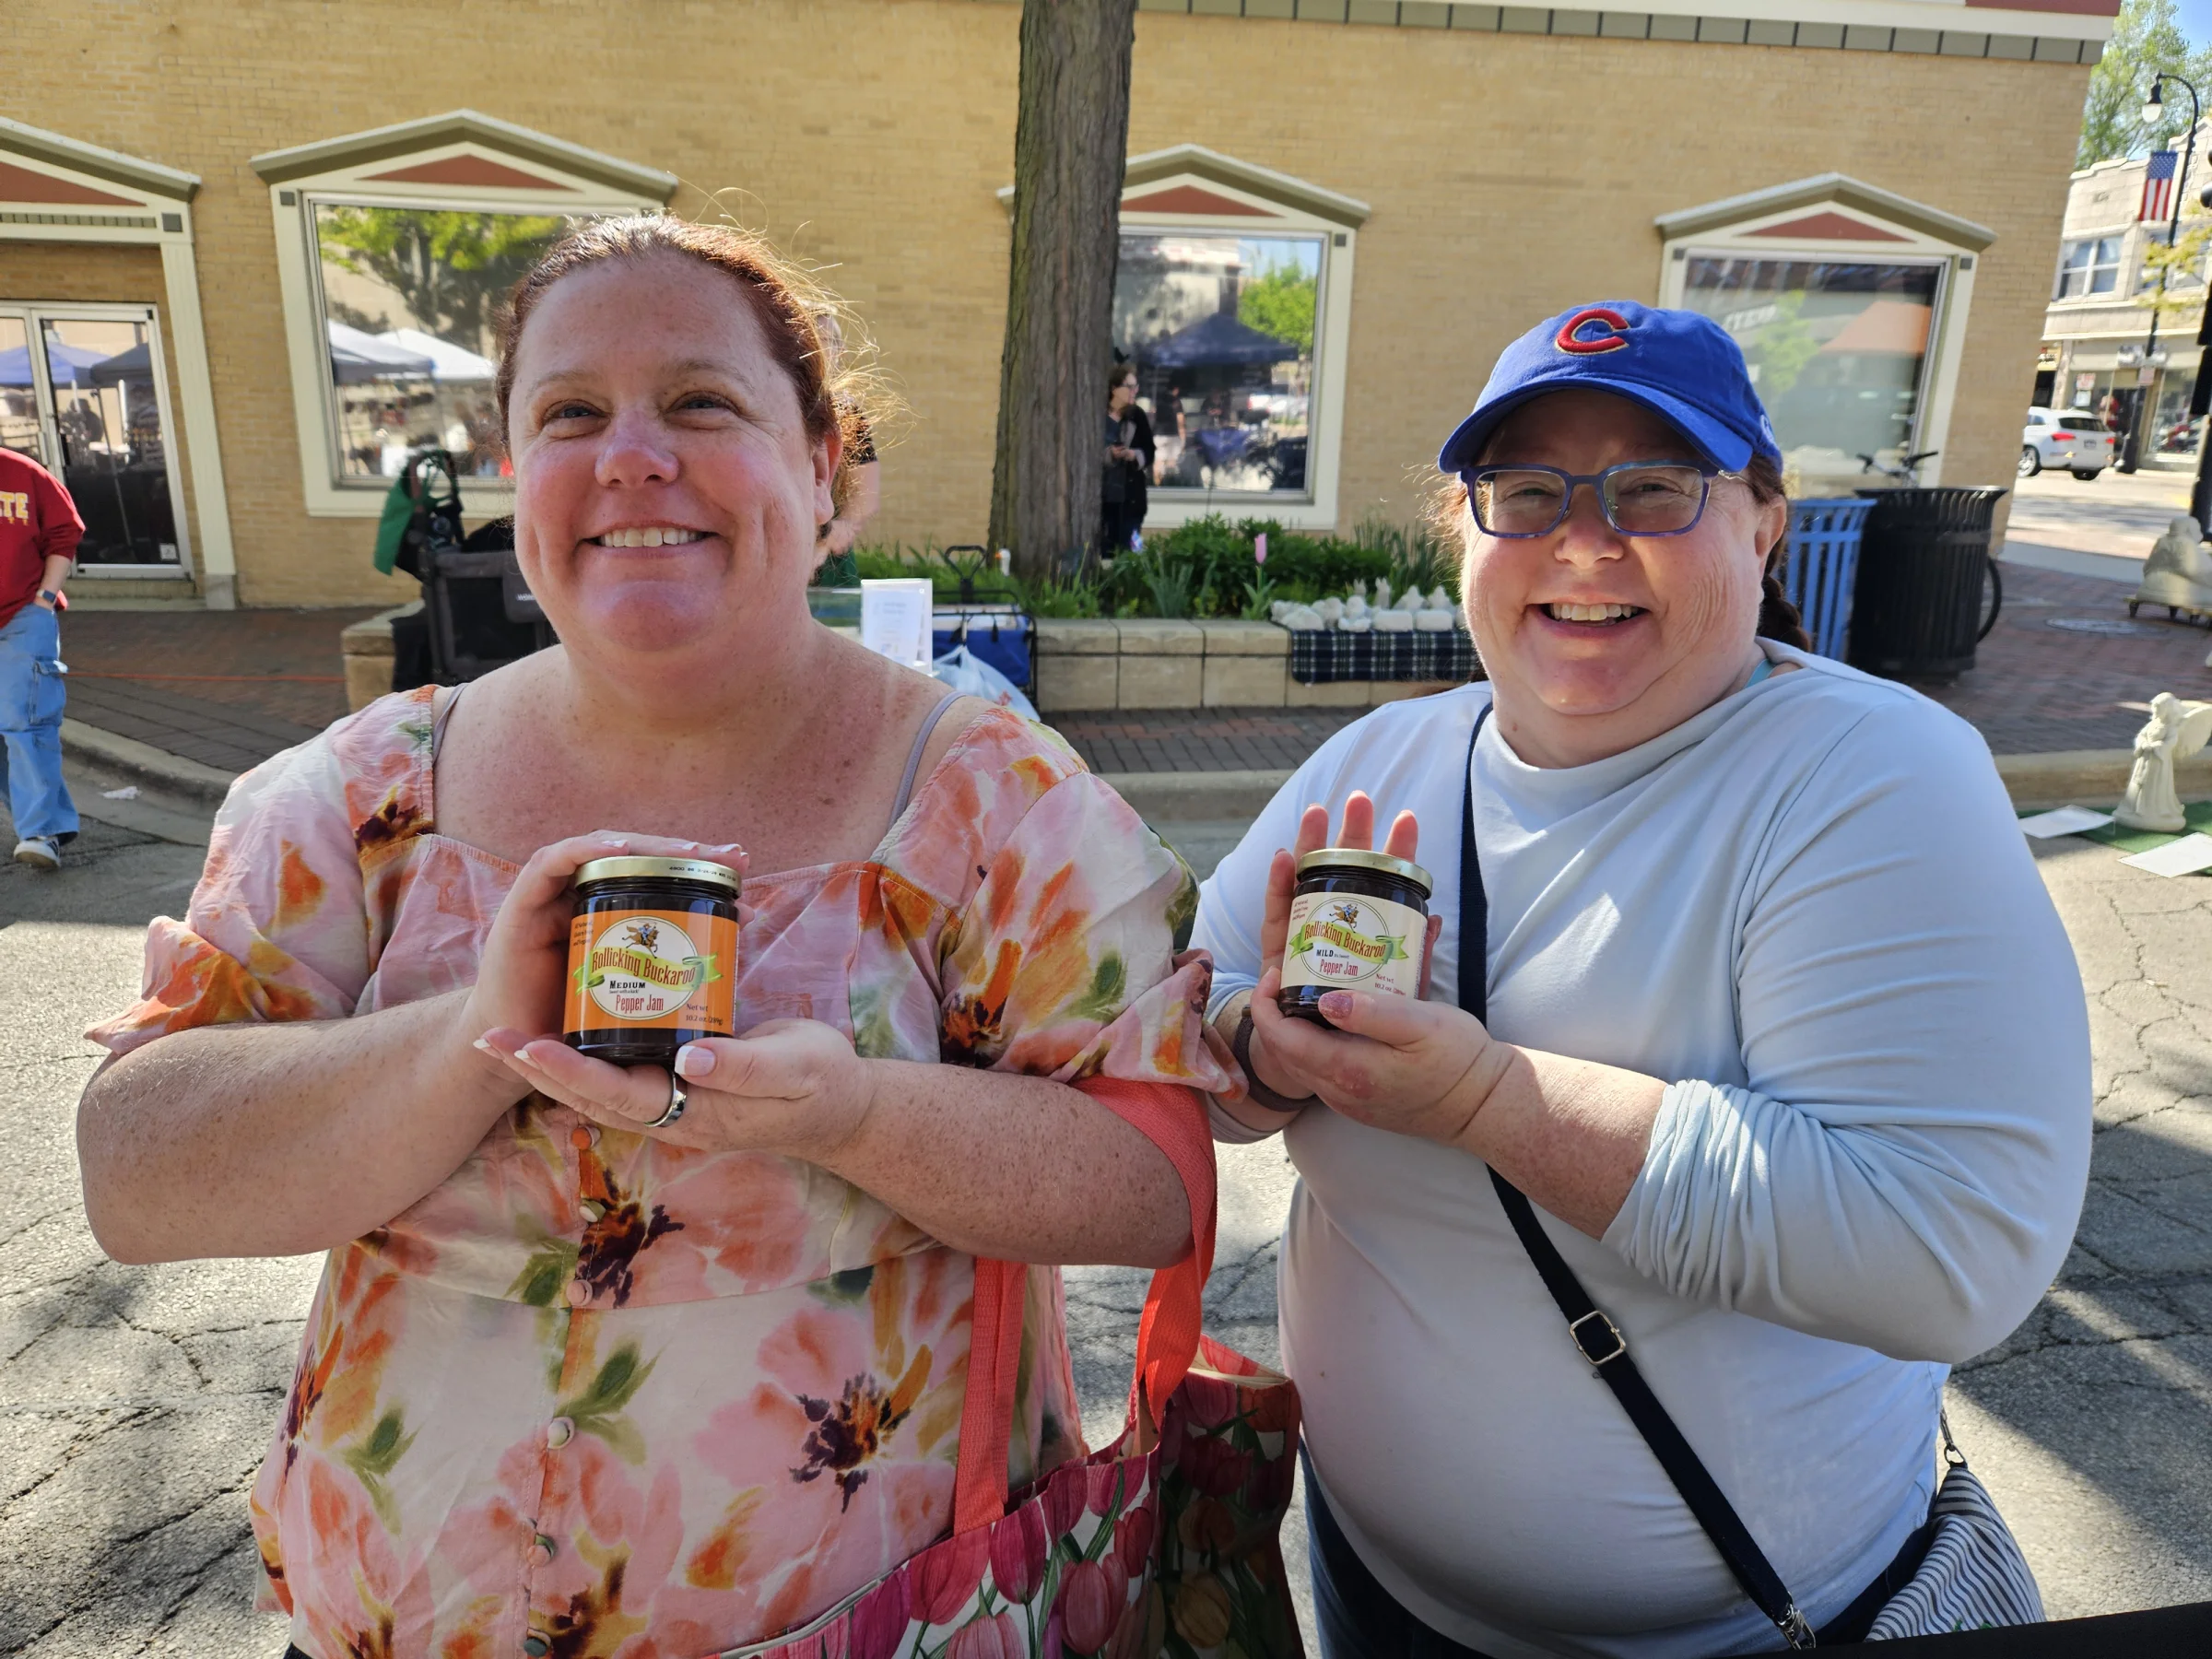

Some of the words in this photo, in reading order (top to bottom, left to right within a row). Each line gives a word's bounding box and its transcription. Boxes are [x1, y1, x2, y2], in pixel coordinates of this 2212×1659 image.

[1555, 308, 1630, 356] C
[0, 490, 29, 520] TE
[1303, 921, 1343, 947] Rollicking
[1344, 932, 1386, 958] Buckaroo
[592, 947, 641, 977] Rollicking
[643, 959, 695, 986] Buckaroo
[1320, 959, 1343, 975] Pepper
[1344, 961, 1358, 977] Jam
[616, 994, 644, 1014] Pepper
[647, 994, 664, 1011] Jam
